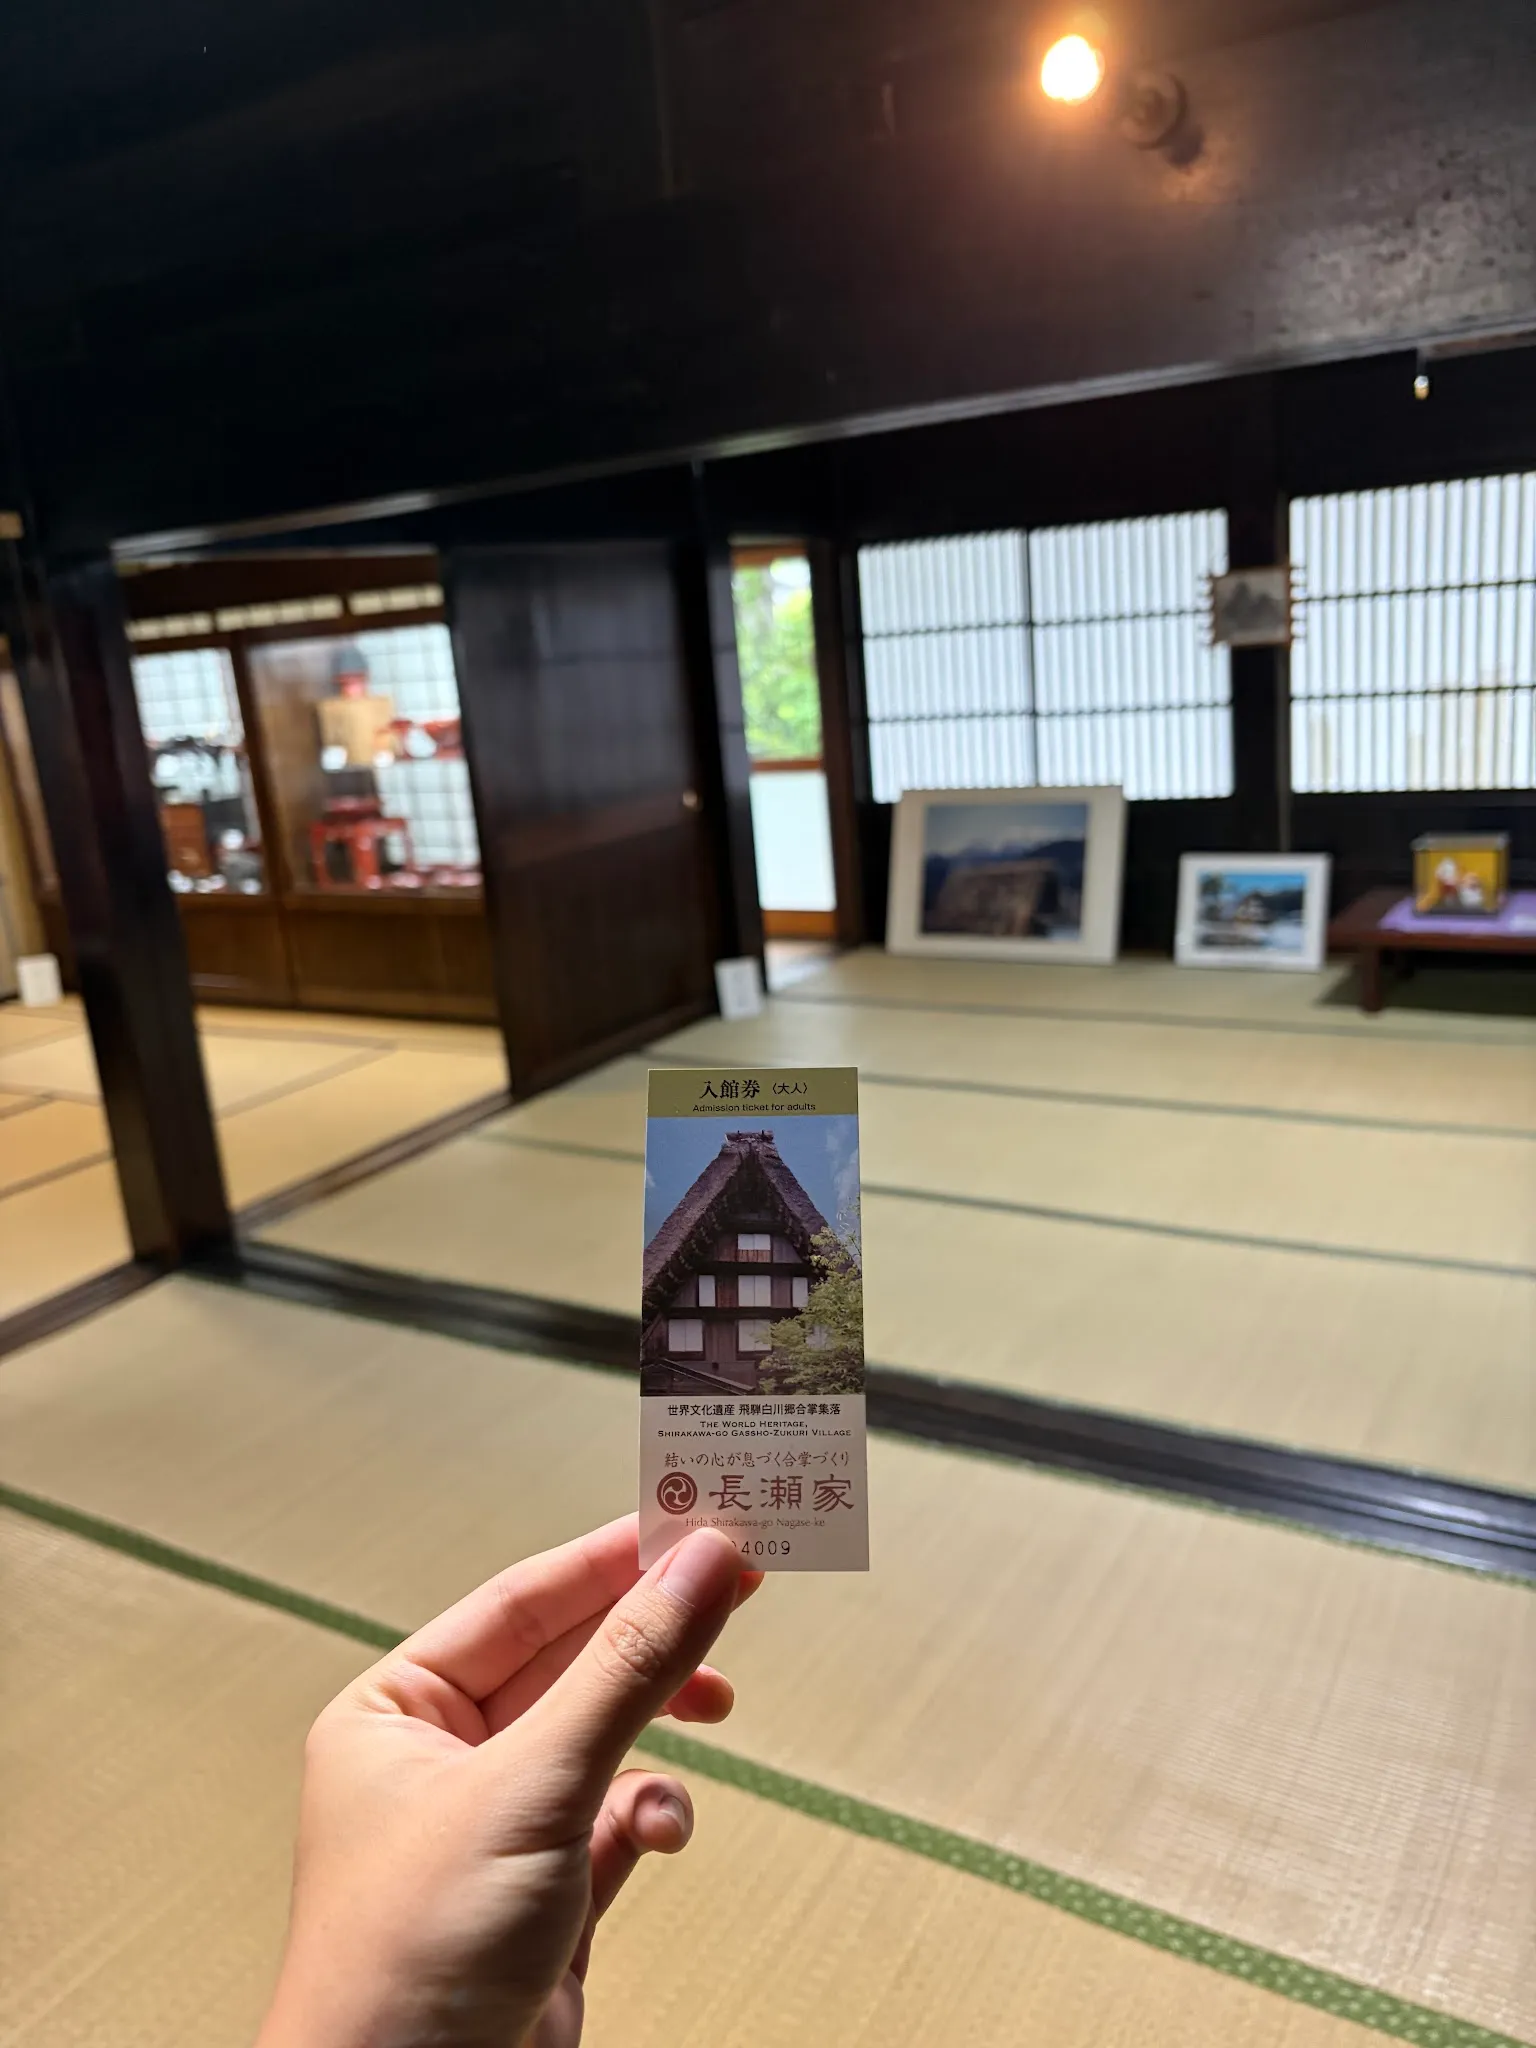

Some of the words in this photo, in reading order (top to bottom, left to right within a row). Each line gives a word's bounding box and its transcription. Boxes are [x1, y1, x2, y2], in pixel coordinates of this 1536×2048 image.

[699, 1079, 761, 1099] 入館券
[692, 1104, 740, 1112] Admission
[771, 1103, 785, 1111] for
[787, 1102, 816, 1111] adults
[667, 1404, 735, 1416] 世界文化遺産
[738, 1403, 841, 1416] 飛騨白川郷合掌集落
[664, 1451, 849, 1468] 結いの心が息づく合掌づくり
[708, 1473, 855, 1513] 長瀬家
[685, 1517, 709, 1527] Hida
[711, 1517, 774, 1528] Shirakawa-go
[776, 1517, 826, 1528] Nagase-ke
[730, 1540, 791, 1556] 4009
